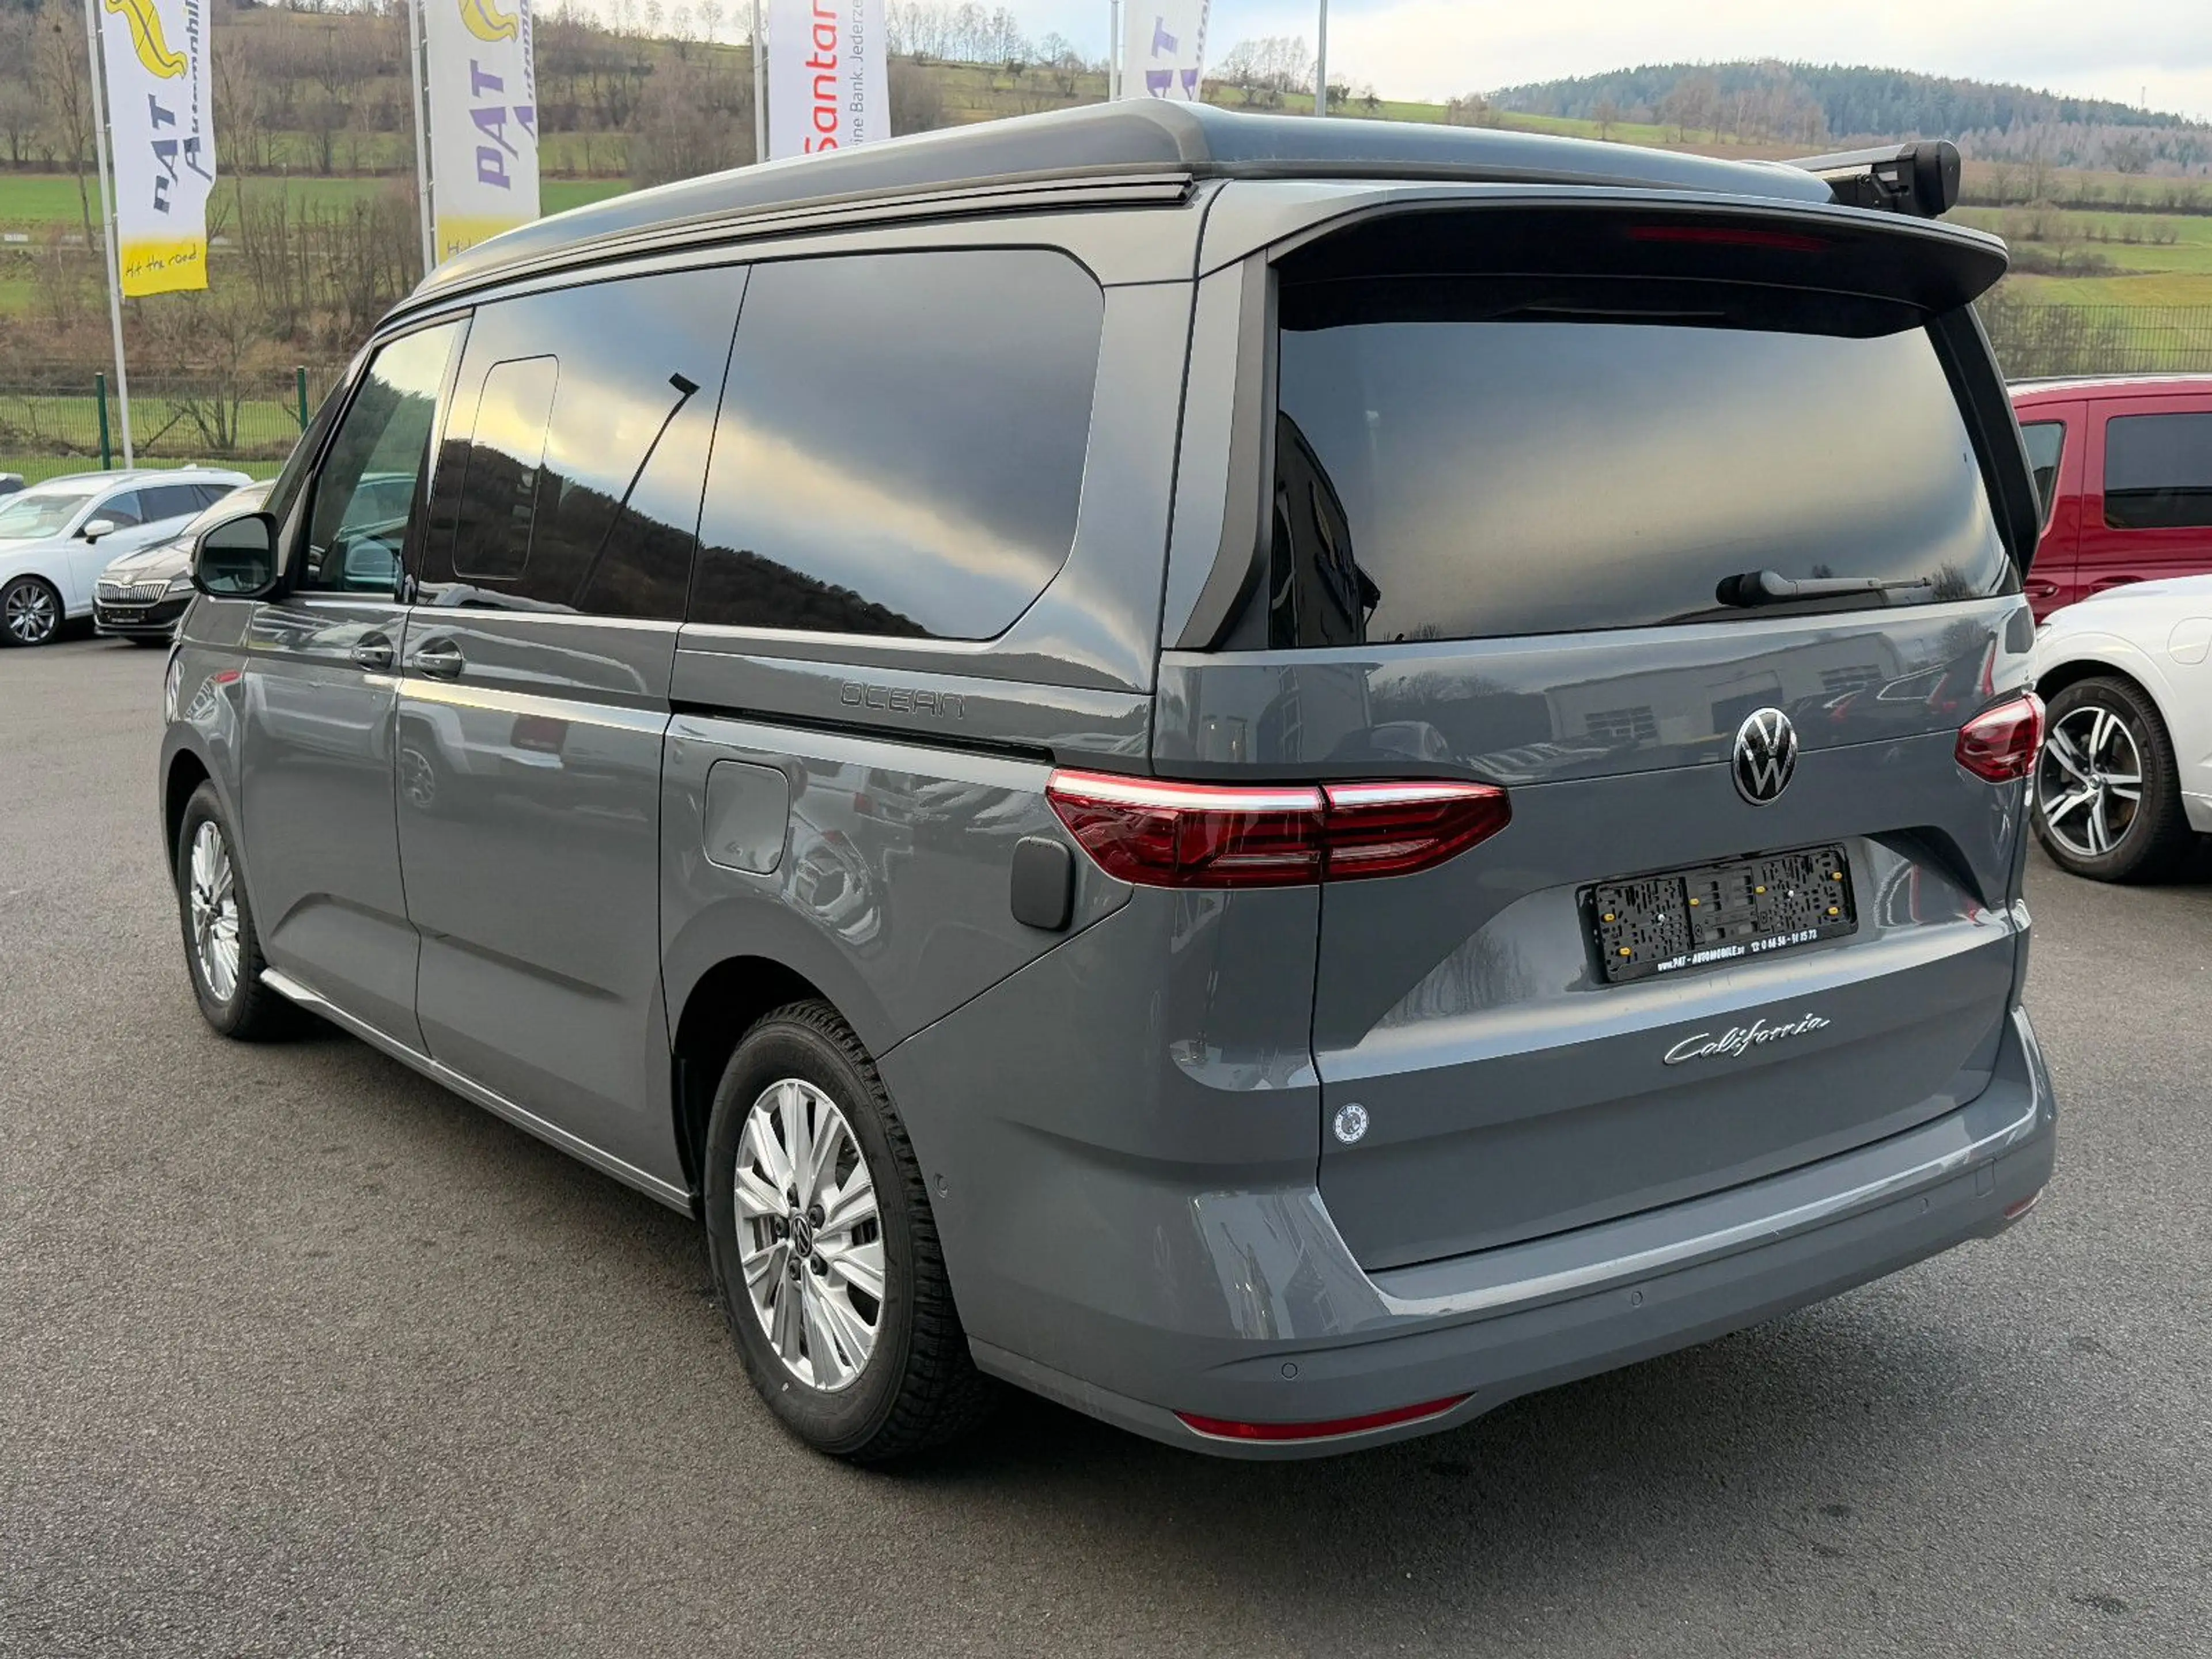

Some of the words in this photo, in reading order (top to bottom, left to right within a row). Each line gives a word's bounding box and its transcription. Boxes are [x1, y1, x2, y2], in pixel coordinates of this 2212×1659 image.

[147, 93, 178, 214] PAT
[469, 59, 518, 190] PAT
[169, 243, 196, 266] road
[841, 682, 965, 719] OCEAN
[1736, 709, 1796, 803] VW
[1664, 1013, 1831, 1064] California
